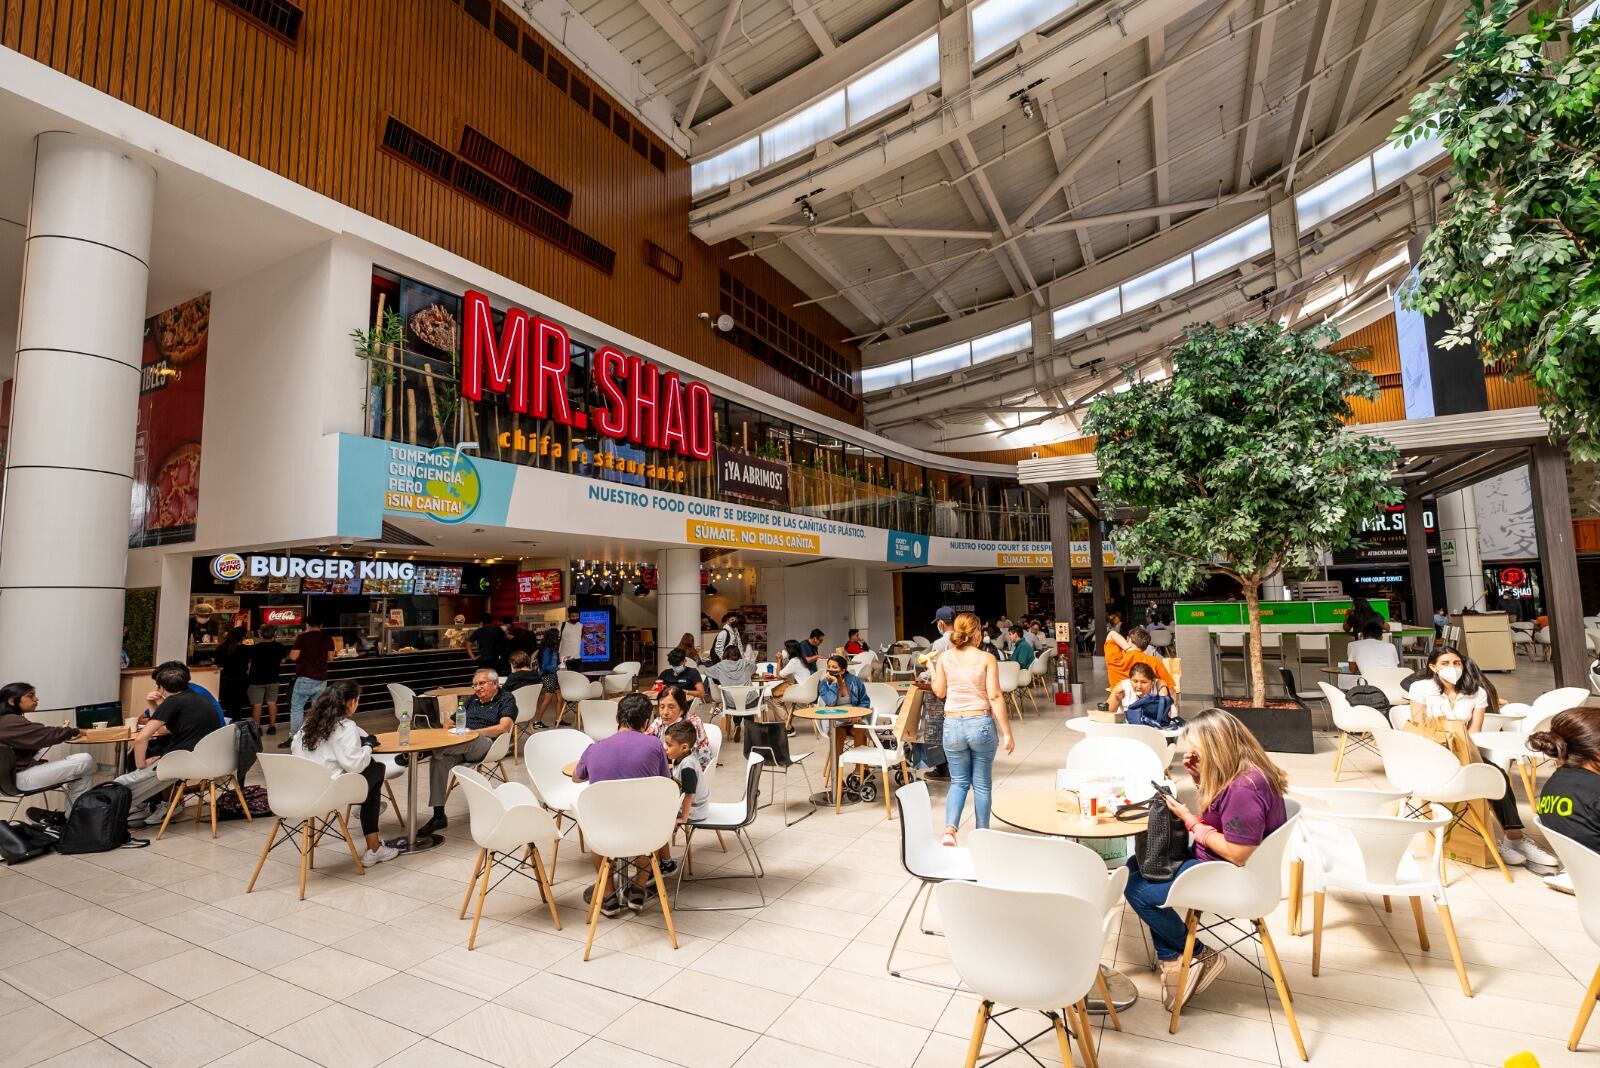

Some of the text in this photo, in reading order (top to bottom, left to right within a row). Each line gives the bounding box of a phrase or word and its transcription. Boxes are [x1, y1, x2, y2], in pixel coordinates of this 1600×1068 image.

[462, 289, 713, 460] MR. SHAO
[389, 446, 450, 468] TOMEMOS
[499, 429, 685, 483] chifa restaurante
[388, 477, 423, 494] PERO
[389, 462, 464, 486] CONCIENCIA,
[724, 460, 783, 491] ¡YA ABRIMOS!
[387, 493, 462, 514] ¡SIN CAÑITA!
[588, 484, 867, 539] NUESTRO FOOD COURT SE DESPIDE DE LAS CAÑITAS DE PLÁSTICO.
[694, 521, 816, 550] SÚMATE. NO PIDAS CAÑITA.
[950, 541, 1087, 552] NUESTRO FOOD COURT SE DESPI LAS
[219, 559, 241, 574] BURGER KING
[249, 555, 415, 580] BURGER KING
[1035, 556, 1049, 565] NO
[1512, 587, 1532, 599] SHAO
